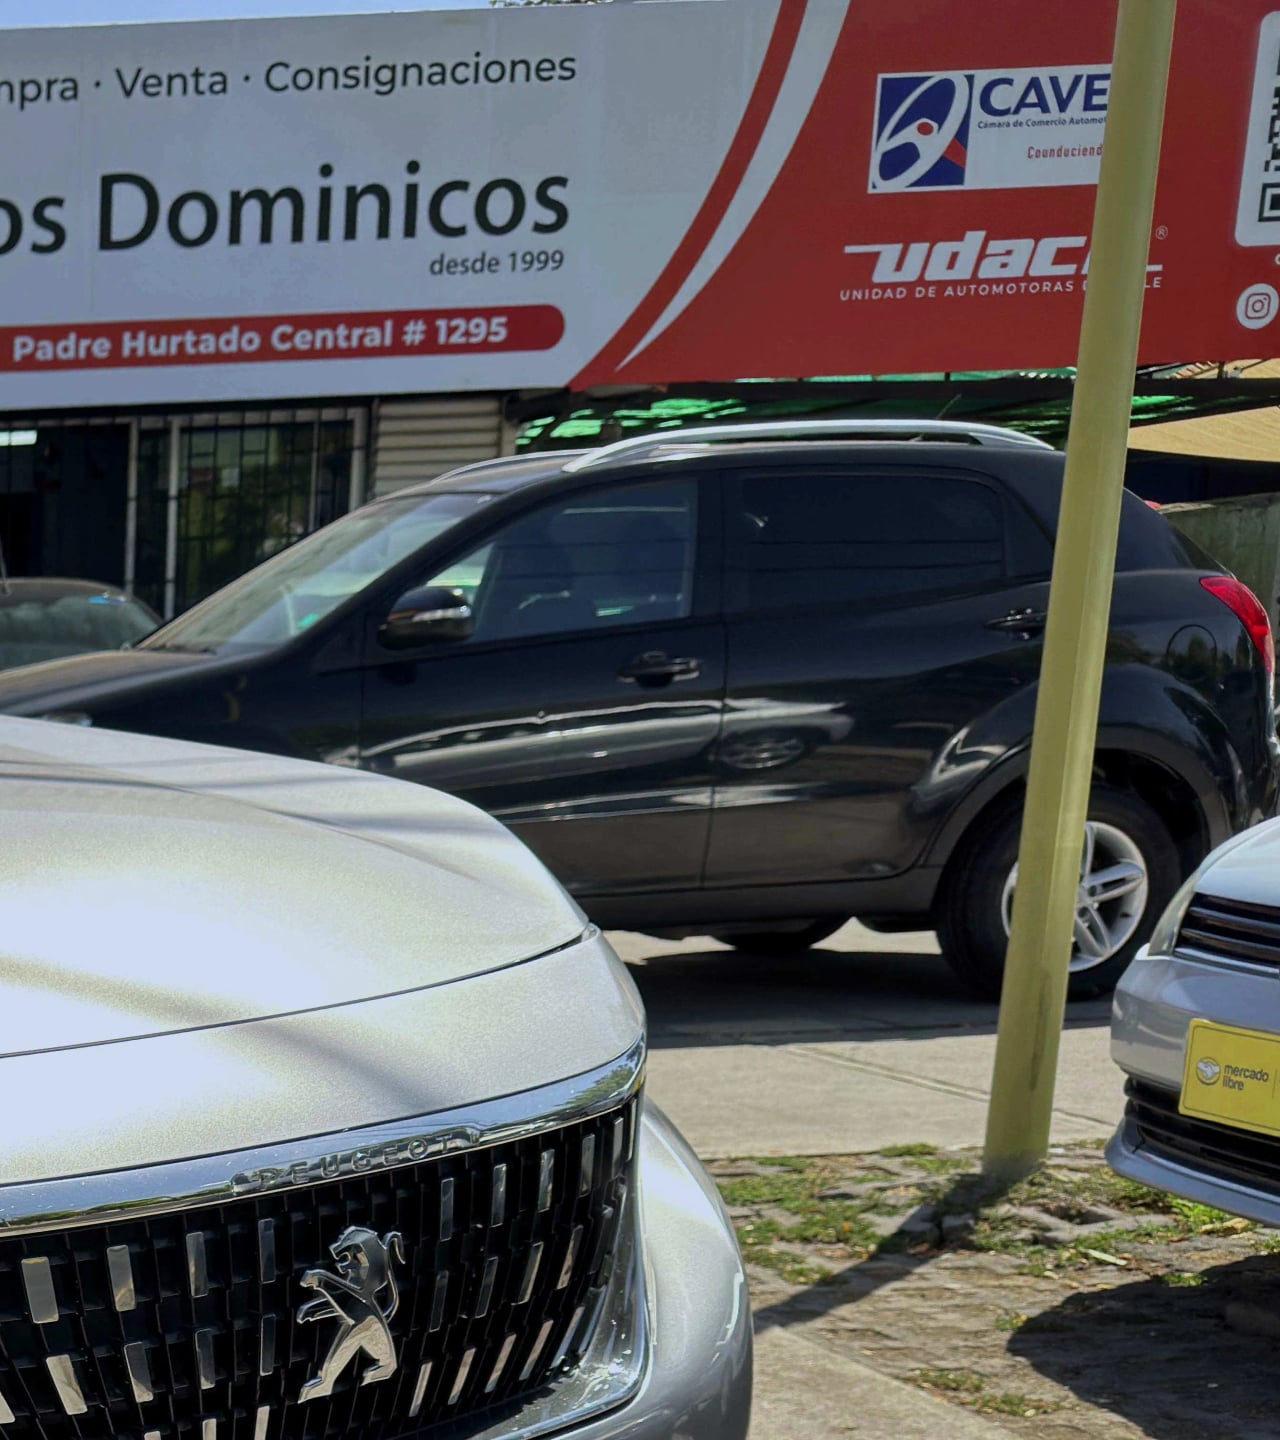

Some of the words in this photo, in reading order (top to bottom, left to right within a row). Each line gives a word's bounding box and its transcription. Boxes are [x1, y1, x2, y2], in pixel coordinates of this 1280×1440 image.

[115, 66, 228, 99] Venta
[264, 51, 576, 96] Consignaciones
[979, 73, 1111, 117] CAVE
[1013, 119, 1024, 128] de
[1025, 116, 1067, 127] Comercio
[1027, 143, 1103, 159] Counduciend
[98, 159, 570, 251] Dominicos
[429, 252, 501, 276] desde
[508, 249, 565, 273] 1999
[840, 287, 907, 301] UNIDAD
[915, 286, 936, 298] DE
[944, 280, 1075, 297] AUTOMOTORAS
[13, 331, 111, 362] Padre
[122, 323, 261, 358] Hurtado
[271, 317, 394, 351] Central
[436, 316, 508, 346] 1295
[1223, 1065, 1269, 1082] mercado
[1223, 1075, 1244, 1090] libre
[255, 1135, 453, 1190] PEUGEOT
